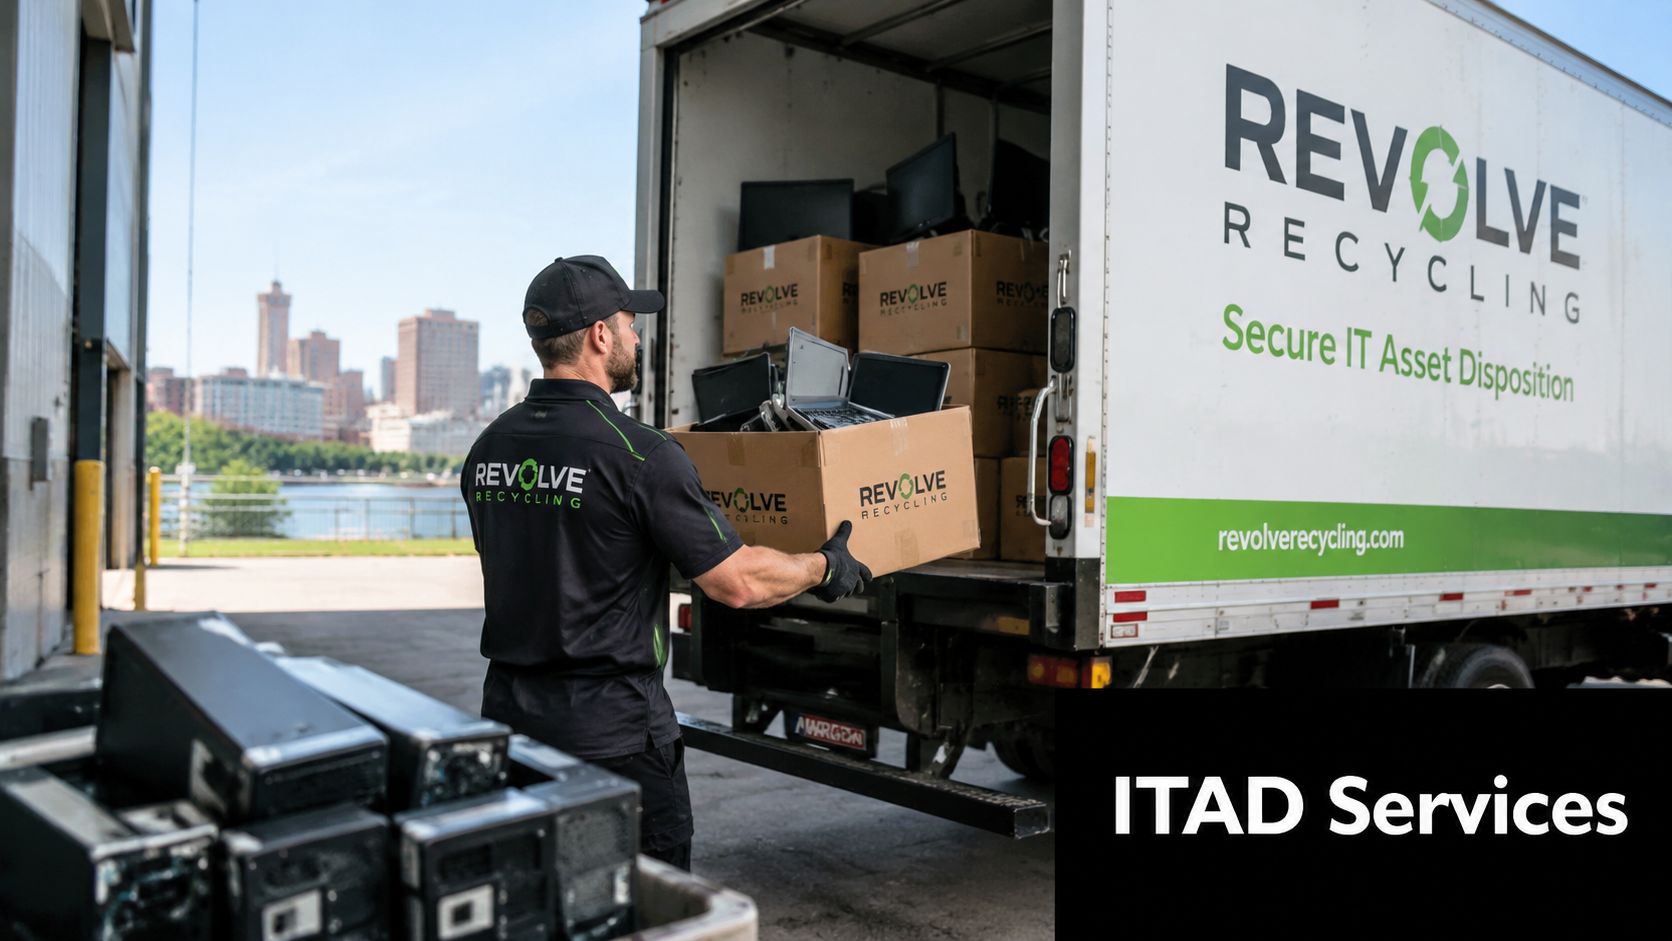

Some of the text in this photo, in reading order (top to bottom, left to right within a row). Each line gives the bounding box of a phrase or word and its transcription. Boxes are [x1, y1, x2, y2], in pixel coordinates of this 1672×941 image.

[1225, 63, 1581, 270] REVOLVE
[1224, 201, 1581, 325] RECYCLING
[741, 283, 798, 306] REVOLVE
[880, 281, 947, 307] REVOLVE
[1222, 303, 1575, 402] Secure IT Asset Disposition
[475, 458, 587, 494] REVOLVE
[859, 470, 947, 507] REVOLVE
[475, 490, 581, 509] RECYCLING
[704, 487, 787, 513] EVOLVE
[861, 492, 947, 519] RECYCLING
[1218, 523, 1404, 556] revolverecycling.com
